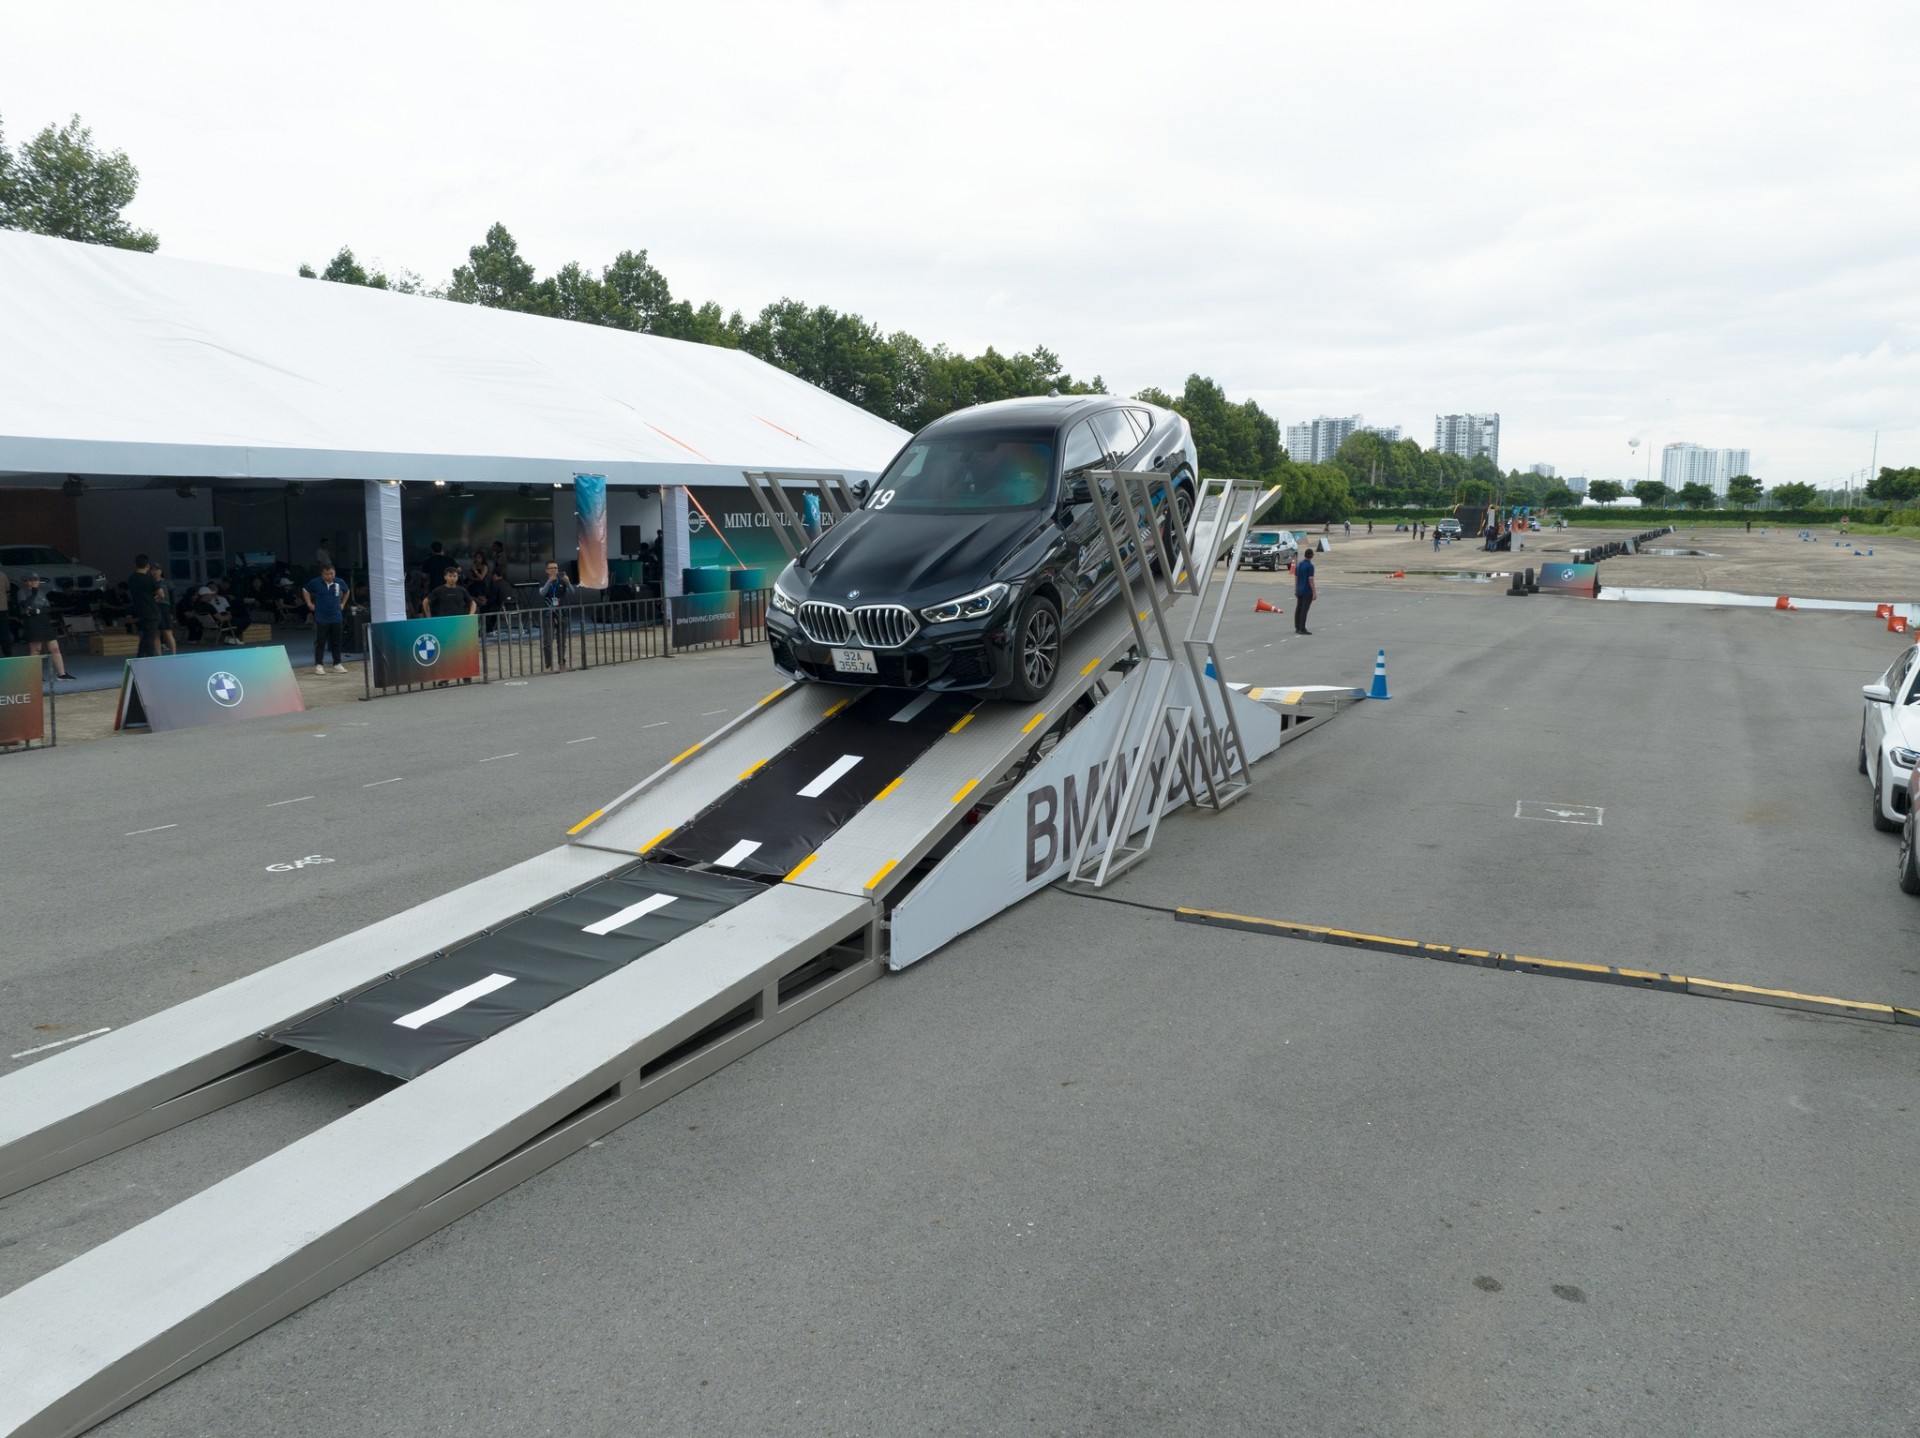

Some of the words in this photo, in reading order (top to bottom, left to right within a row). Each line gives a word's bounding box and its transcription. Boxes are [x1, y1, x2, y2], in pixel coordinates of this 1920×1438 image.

[867, 489, 896, 510] 19
[724, 513, 752, 528] MINI
[689, 615, 708, 624] DRIVING
[708, 612, 736, 622] EXPERIENCE
[843, 651, 863, 661] 92A
[265, 855, 336, 872] GAS
